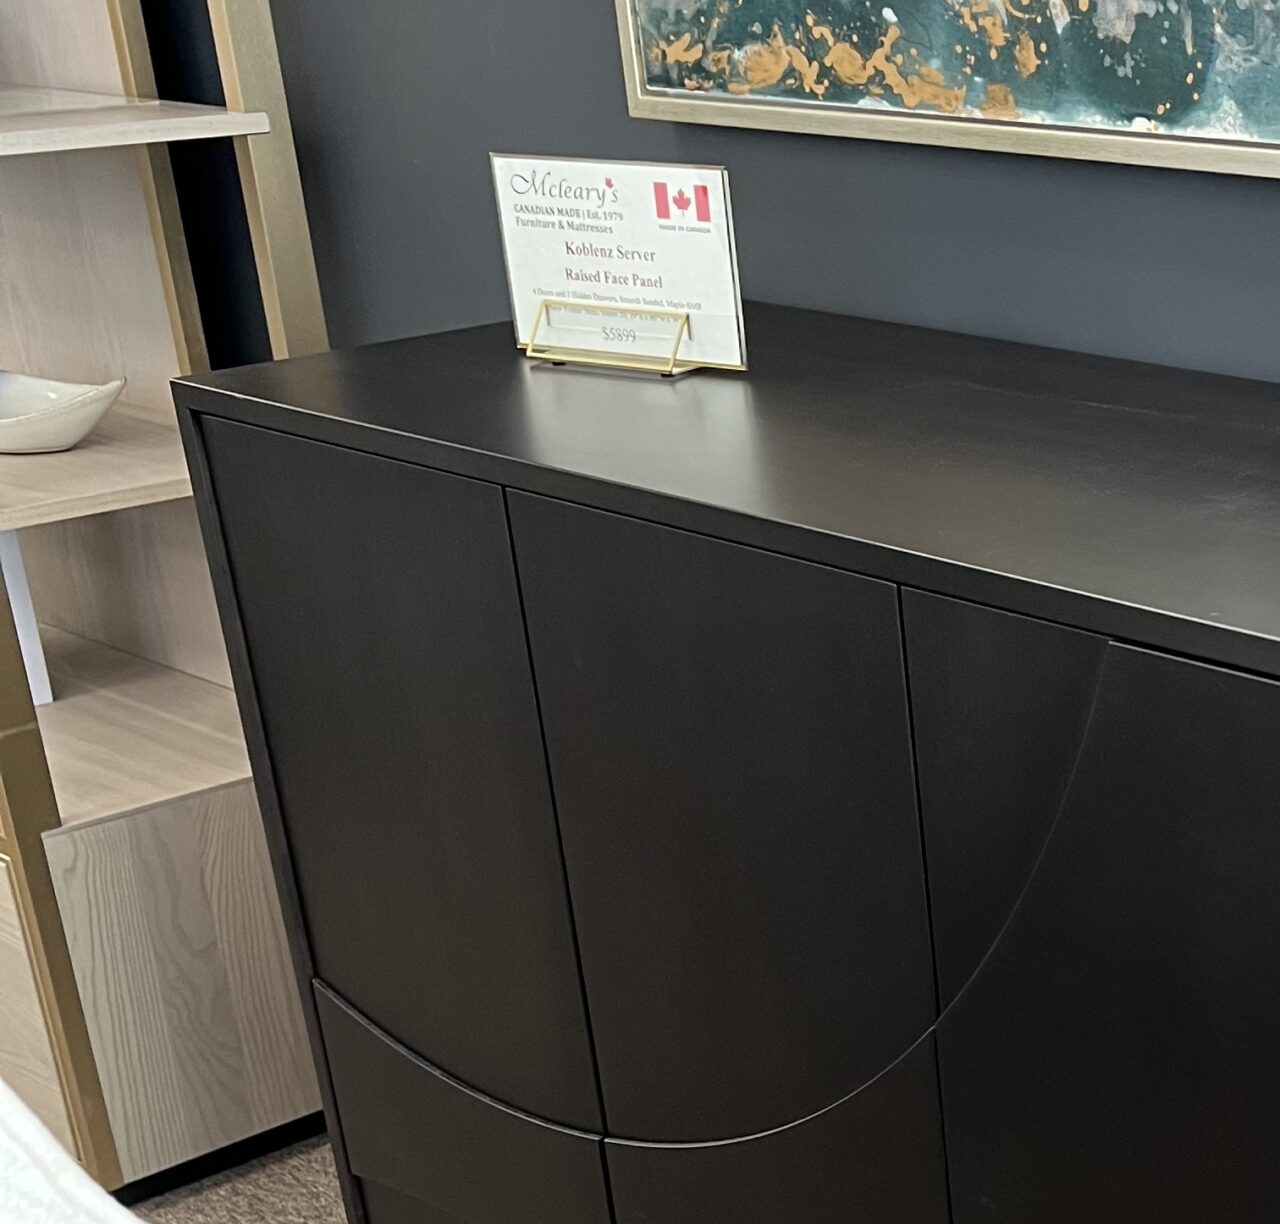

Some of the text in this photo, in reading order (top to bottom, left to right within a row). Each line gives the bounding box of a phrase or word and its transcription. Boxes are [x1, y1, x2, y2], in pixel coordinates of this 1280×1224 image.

[510, 169, 619, 209] Mcleary's
[513, 203, 555, 216] CANADIAN
[556, 206, 580, 219] MADE
[603, 210, 624, 222] 1979
[516, 216, 614, 234] Furniture & Mattresses
[565, 241, 656, 262] Koblenz Server
[565, 268, 663, 289] Raised Face Panel
[601, 326, 637, 343] $5899
